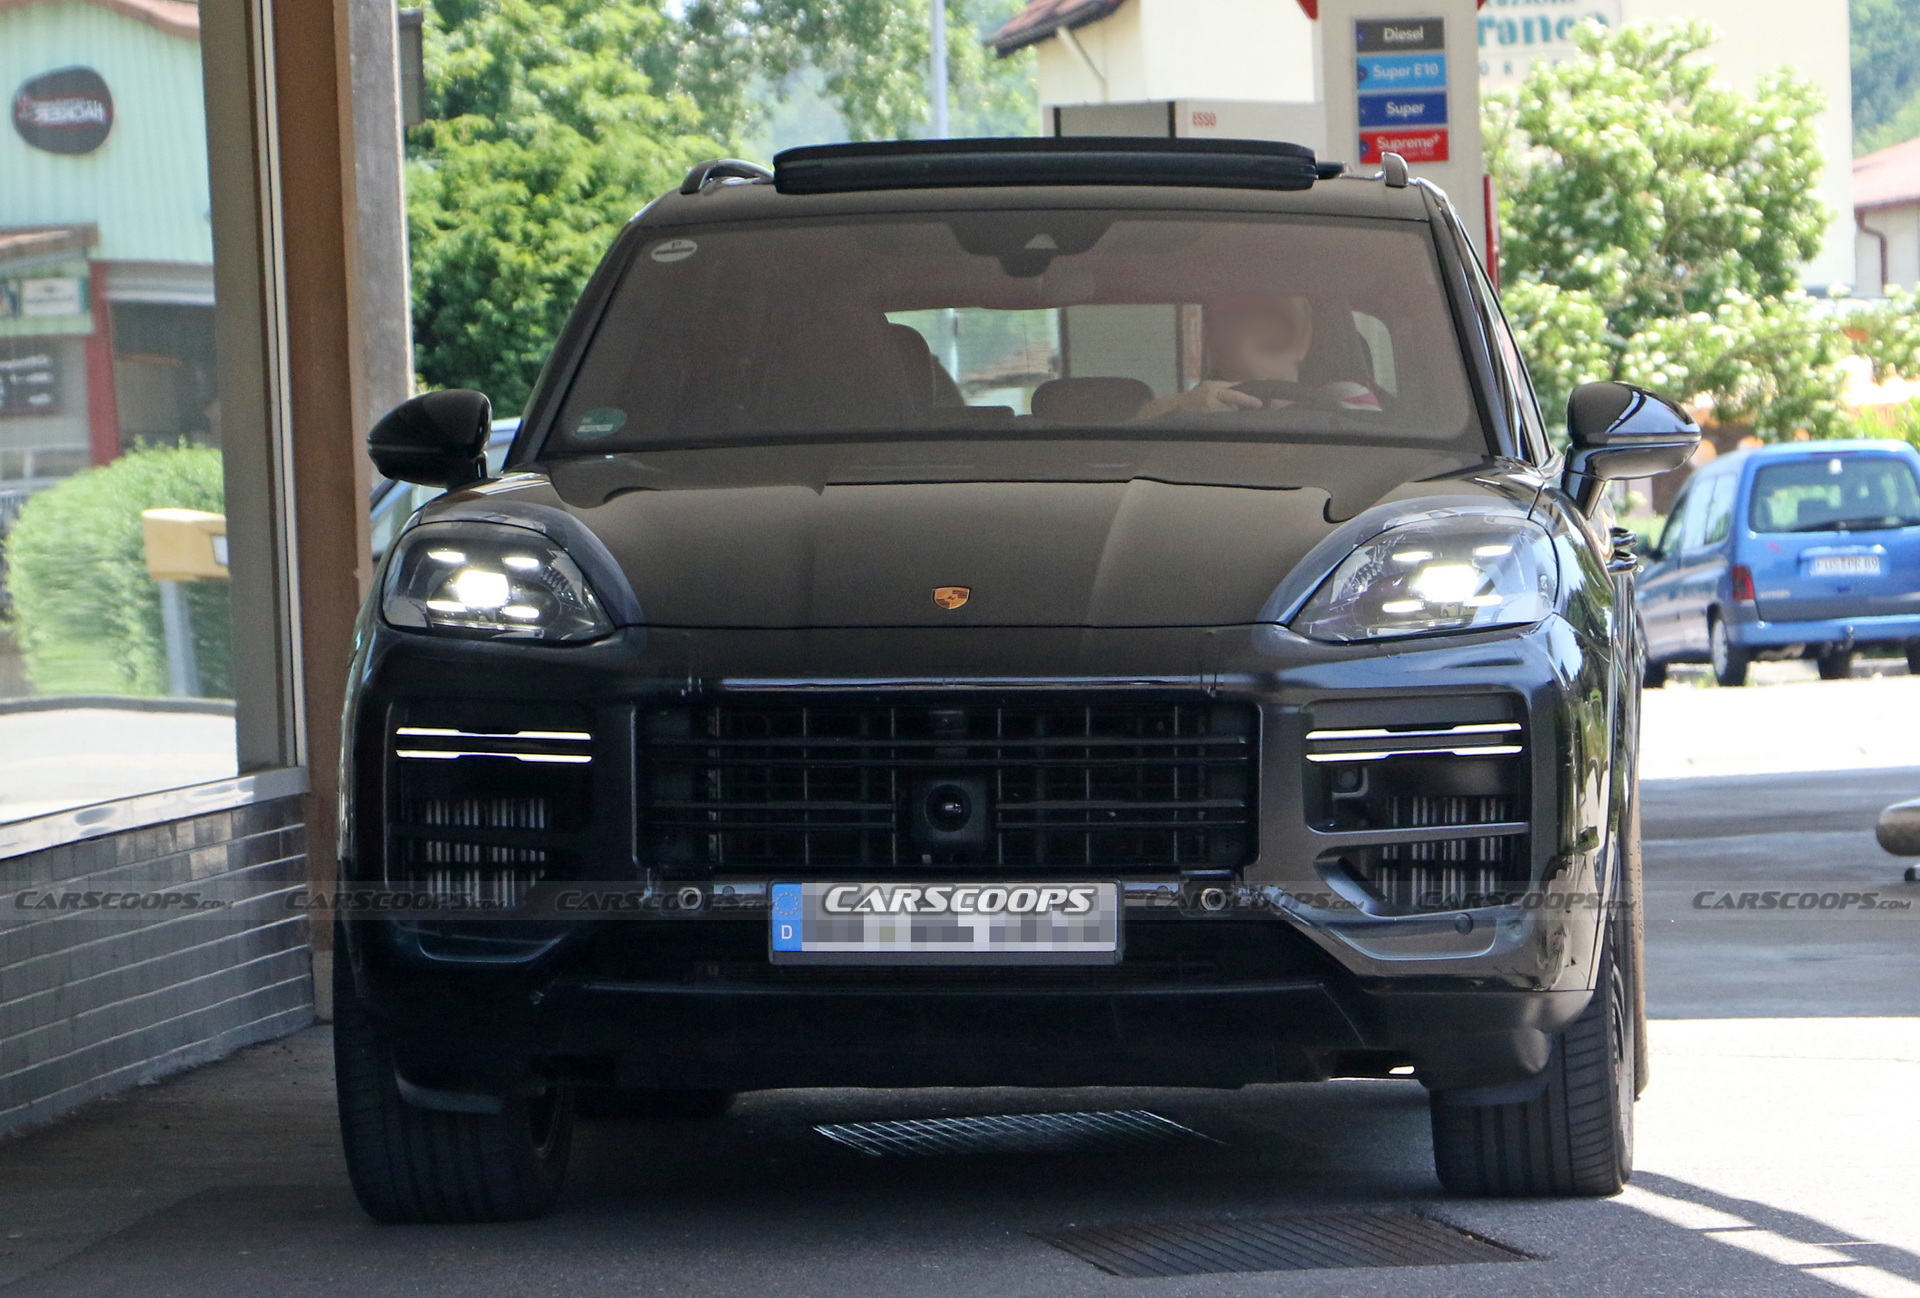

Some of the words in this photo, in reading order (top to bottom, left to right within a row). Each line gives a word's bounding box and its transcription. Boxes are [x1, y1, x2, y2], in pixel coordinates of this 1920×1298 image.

[1384, 26, 1424, 41] Diesel
[1373, 64, 1410, 79] Super
[1414, 62, 1439, 76] E10
[1386, 101, 1425, 117] Super
[1192, 111, 1217, 127] ESSO
[781, 925, 793, 940] D
